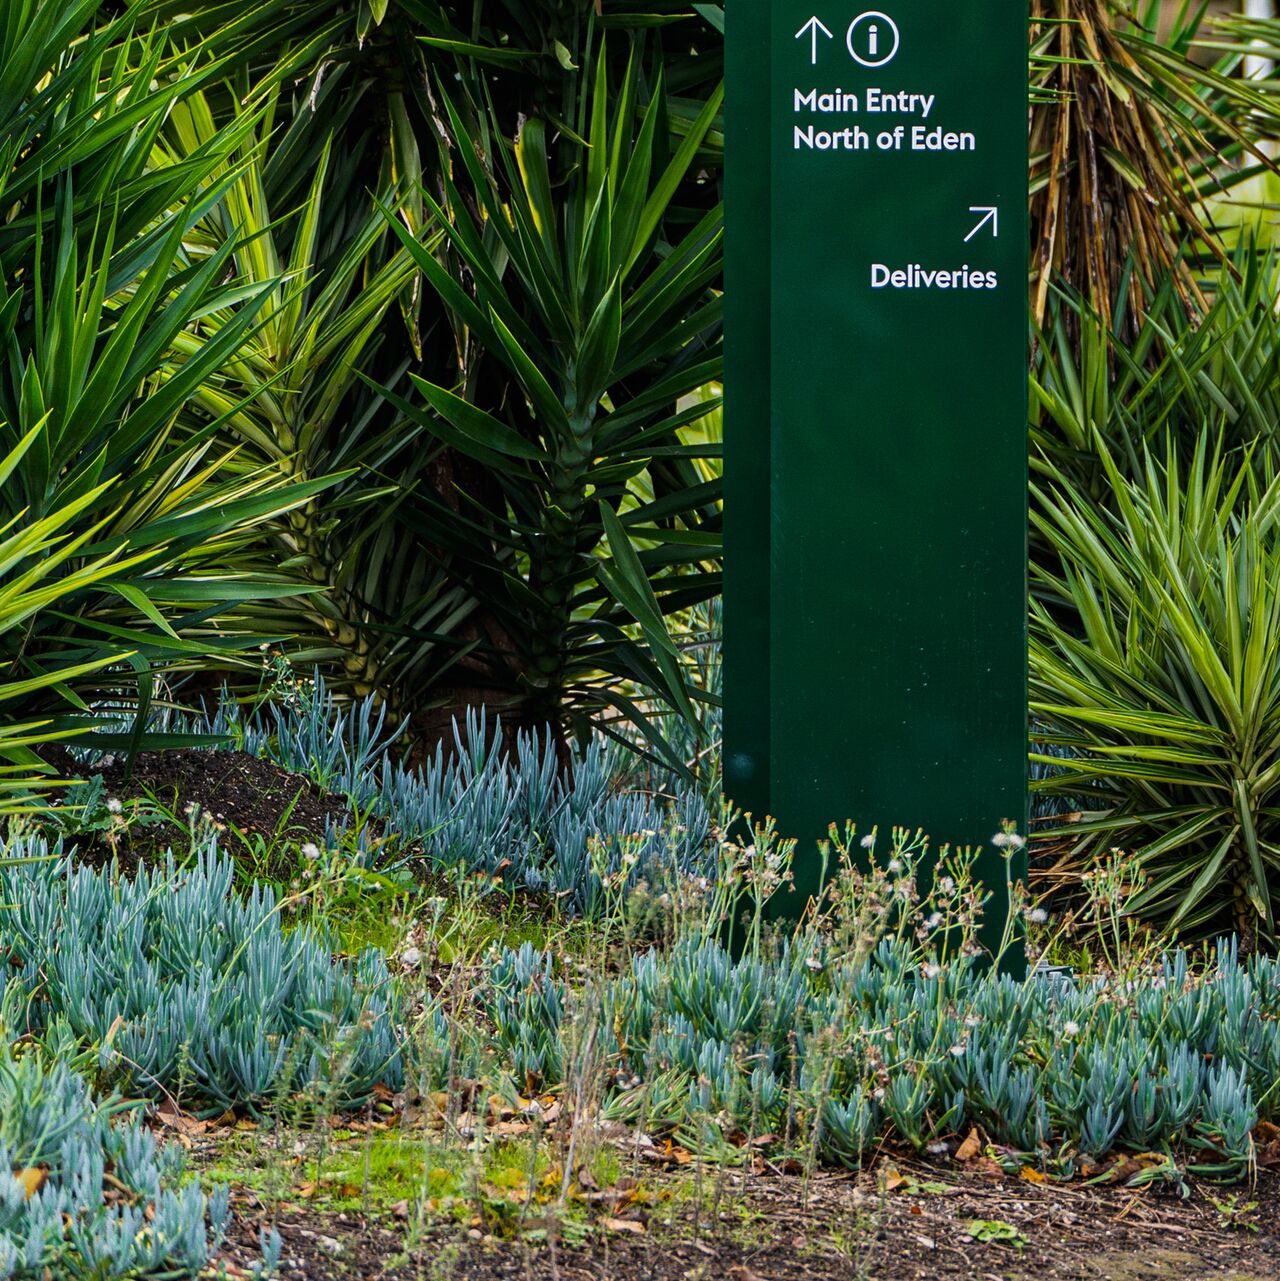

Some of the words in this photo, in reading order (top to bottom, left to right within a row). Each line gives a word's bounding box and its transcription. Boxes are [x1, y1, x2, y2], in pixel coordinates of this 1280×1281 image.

[794, 88, 858, 112] Main
[866, 88, 935, 118] Entry
[793, 125, 869, 150] North
[876, 125, 905, 150] of
[911, 125, 976, 151] Eden
[871, 263, 998, 289] Deliveries
